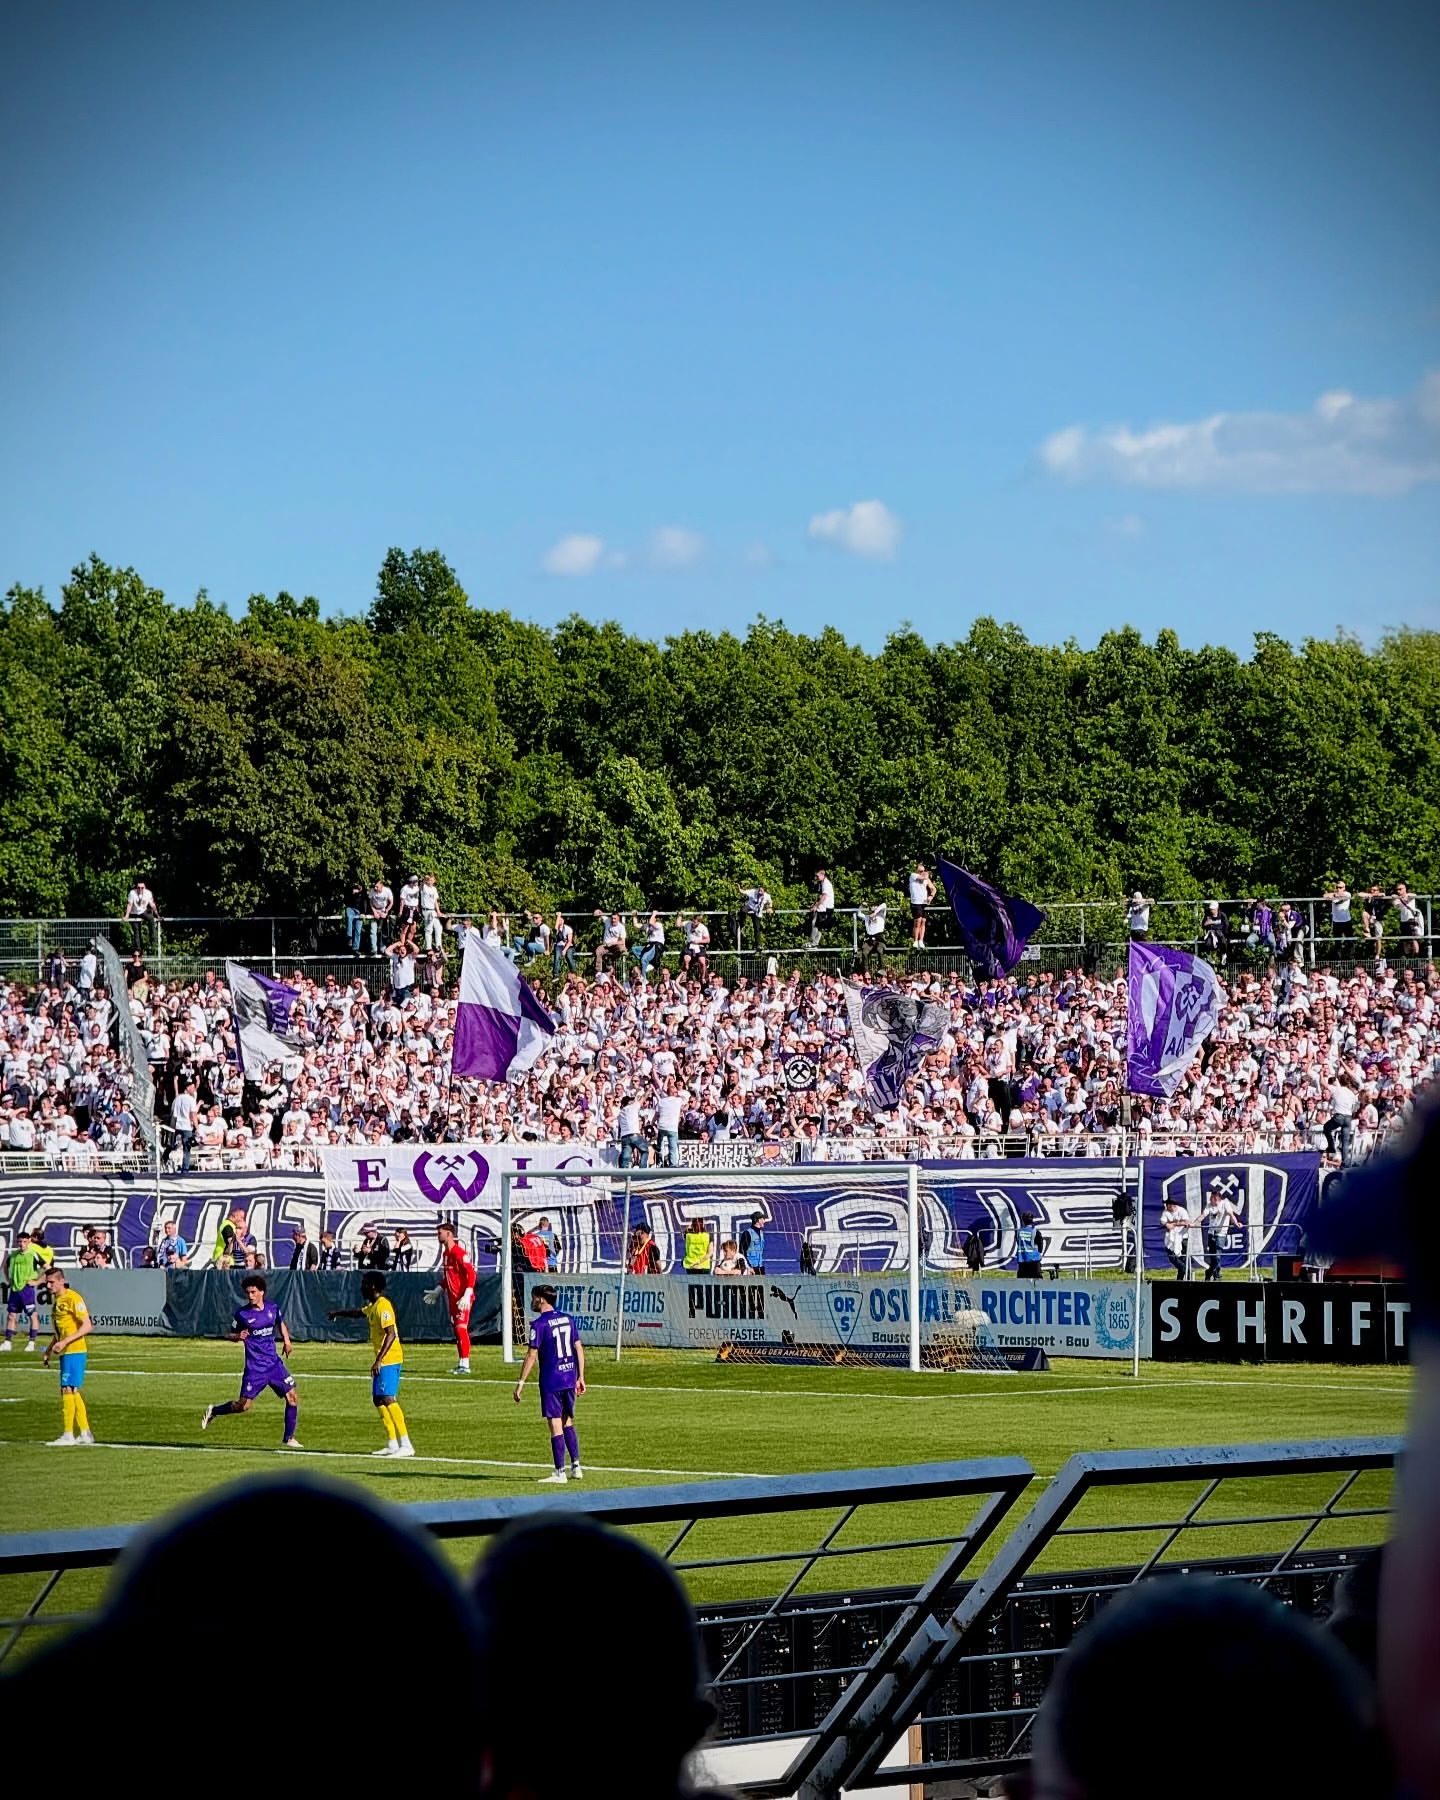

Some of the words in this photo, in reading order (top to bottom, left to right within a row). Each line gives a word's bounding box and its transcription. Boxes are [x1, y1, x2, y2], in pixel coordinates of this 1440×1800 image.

[678, 1144, 749, 1155] FREIHEIT
[804, 1189, 1132, 1272] AUE
[588, 1286, 611, 1312] for
[615, 1286, 665, 1313] Teams
[688, 1284, 765, 1319] PUMA
[834, 1296, 855, 1312] OR
[981, 1290, 1091, 1325] RICHTER
[91, 1315, 158, 1327] S-SYSTEMBAU.DE
[595, 1316, 612, 1331] Fan
[841, 1316, 850, 1331] S
[1108, 1313, 1130, 1330] 1865
[1160, 1298, 1411, 1347] SCHRIFT
[552, 1325, 572, 1358] 17
[998, 1335, 1056, 1347] Transport
[1066, 1336, 1090, 1347] Bau
[768, 1348, 783, 1356] DER
